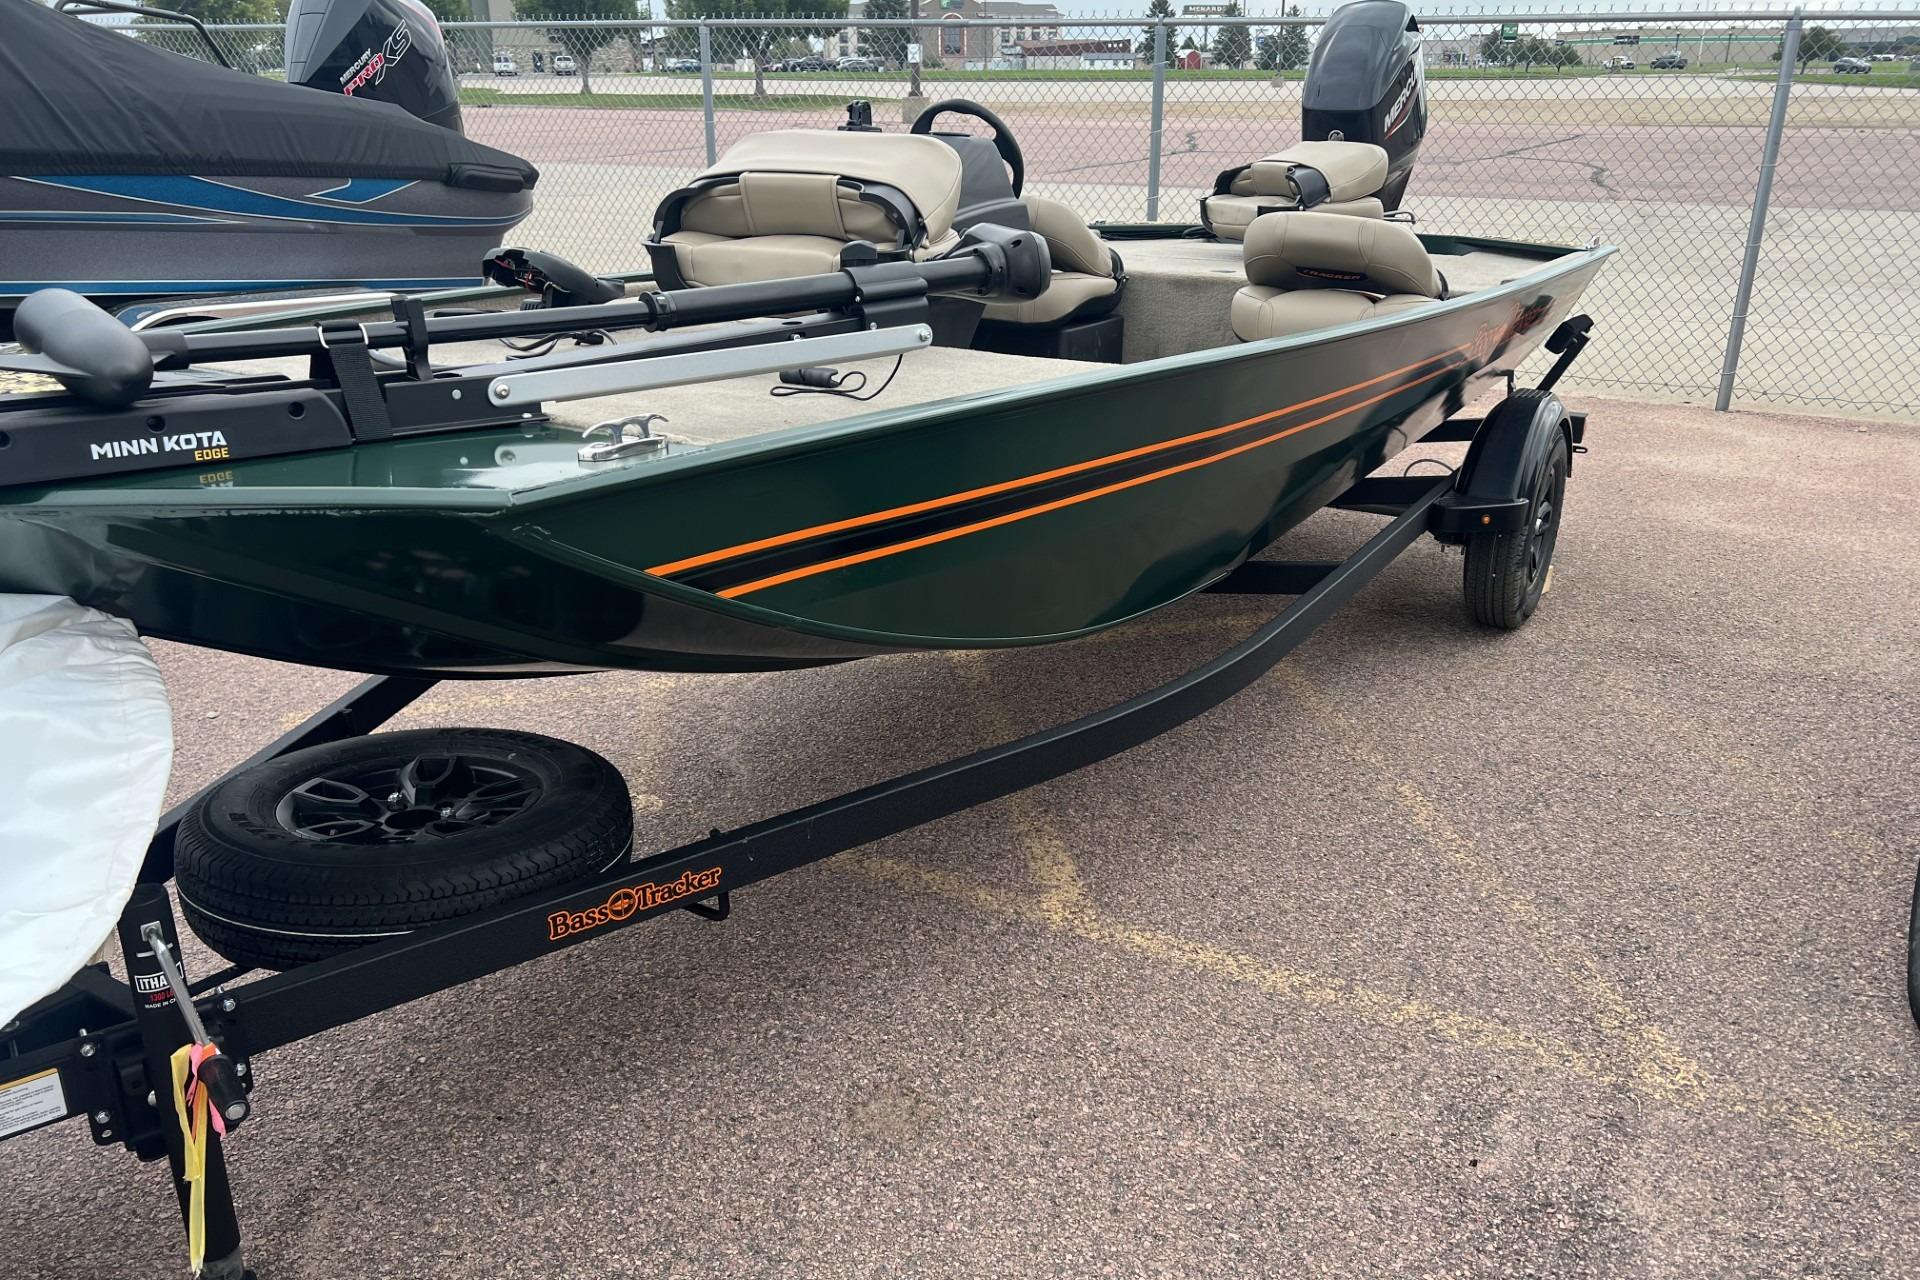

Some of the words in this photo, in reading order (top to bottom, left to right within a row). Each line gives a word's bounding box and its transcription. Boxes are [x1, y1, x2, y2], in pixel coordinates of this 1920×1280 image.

[340, 48, 372, 85] MERCURY
[343, 52, 385, 96] PRO
[375, 19, 412, 86] XS
[1384, 71, 1416, 133] MERCU
[90, 437, 158, 460] MINN
[163, 430, 227, 452] KOTA
[194, 447, 230, 461] EDGE
[548, 910, 610, 941] Bass
[634, 867, 722, 910] Tracker
